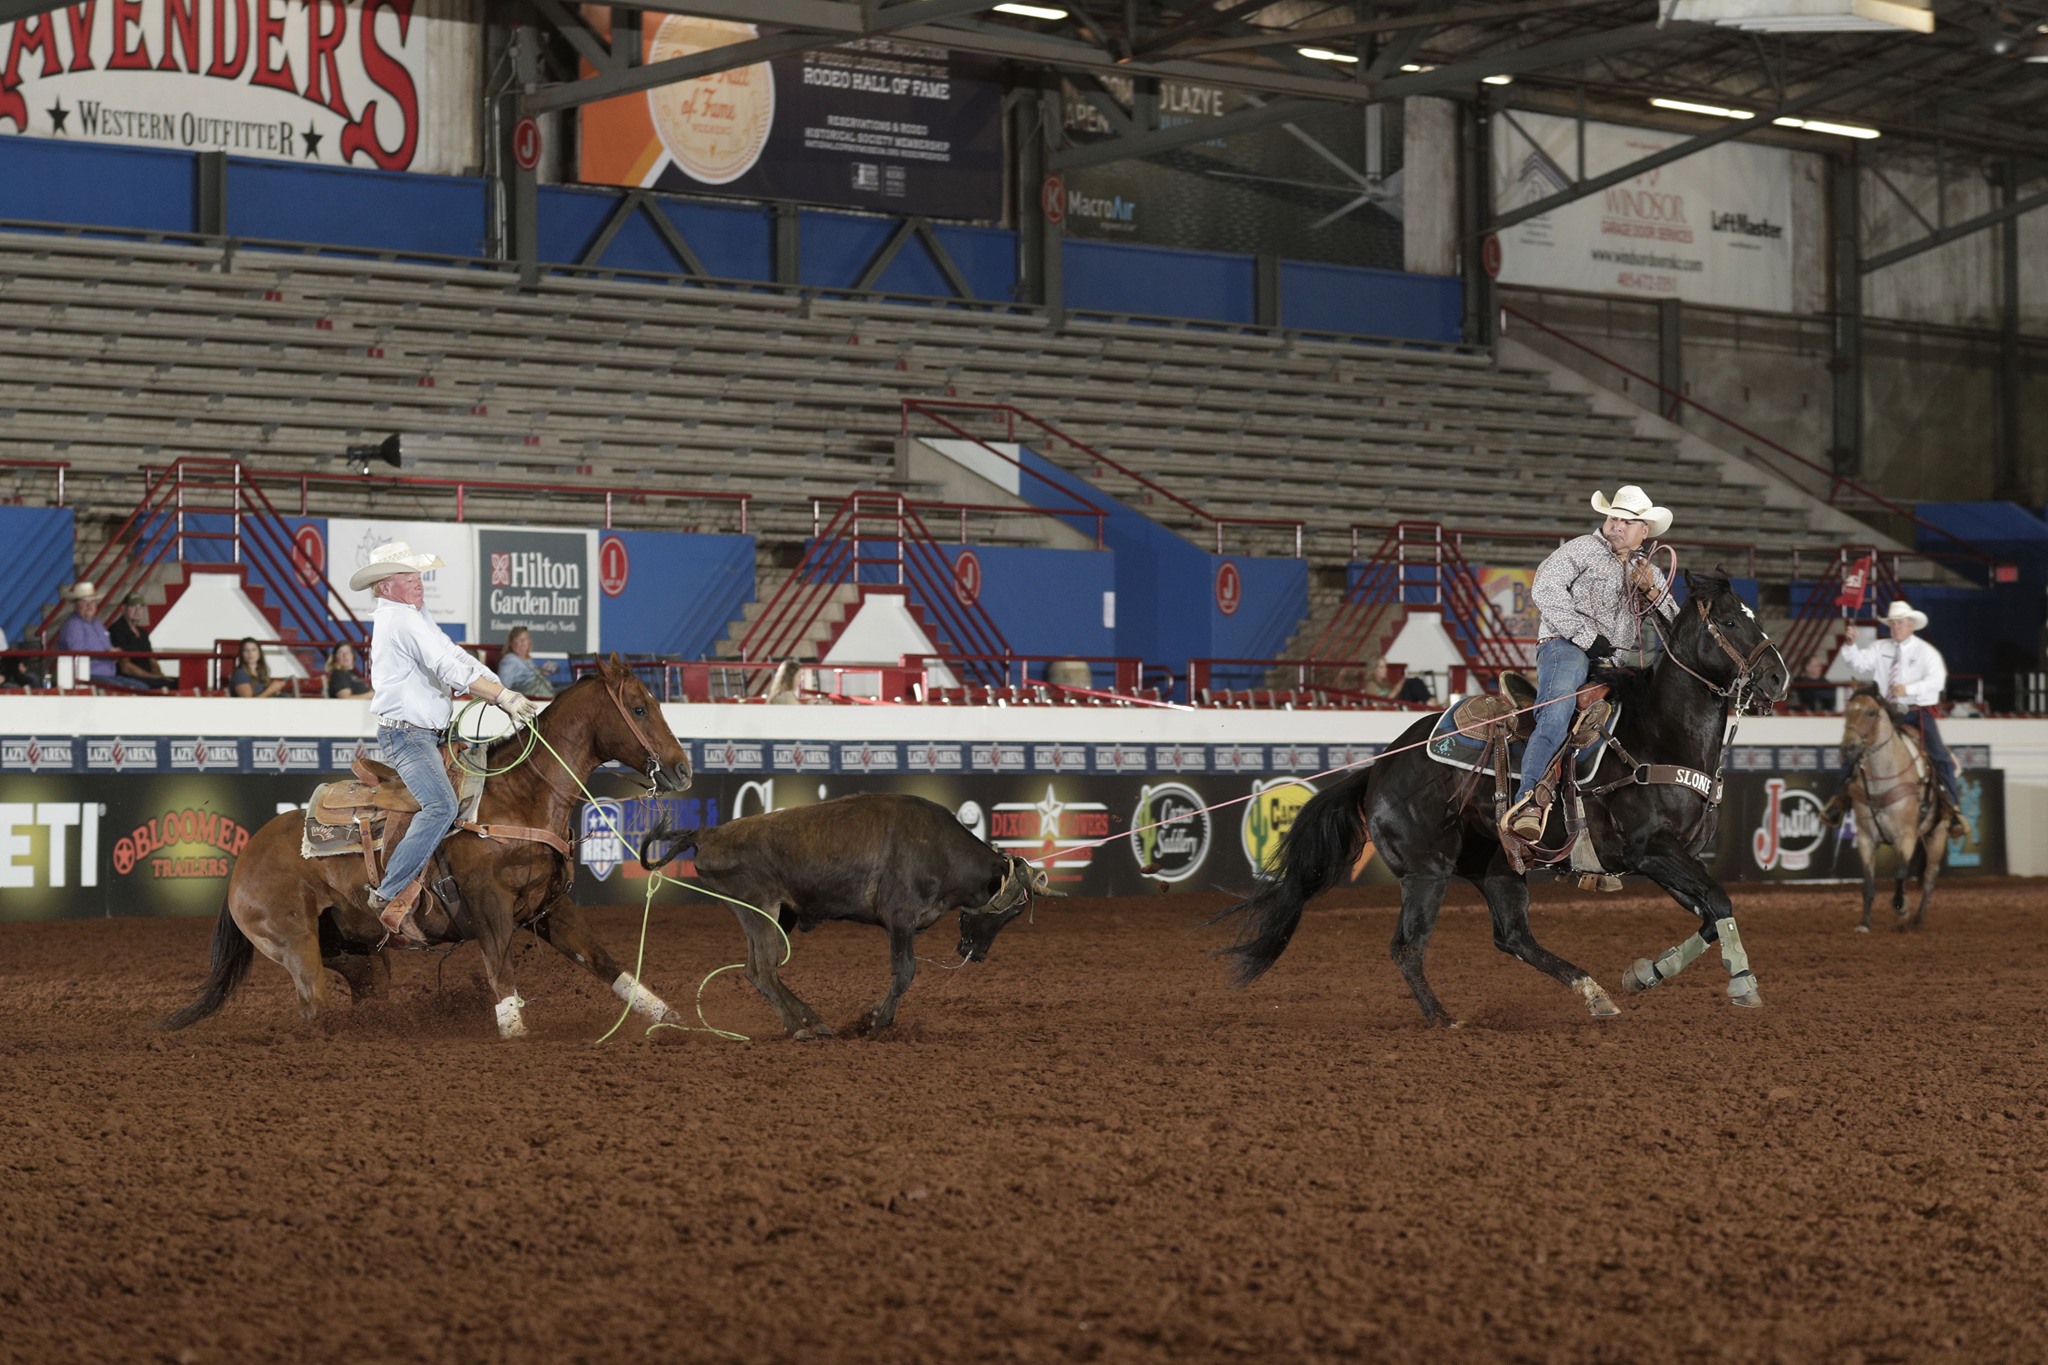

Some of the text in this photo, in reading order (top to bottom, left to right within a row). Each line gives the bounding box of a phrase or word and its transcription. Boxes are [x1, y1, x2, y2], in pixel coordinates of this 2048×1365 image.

[0, 0, 419, 172] AVENDERS
[803, 67, 950, 99] RODEO HALL OF FAME
[78, 100, 295, 156] WESTERN OUTFITTER
[510, 552, 580, 589] Hilton
[490, 589, 579, 617] Garden Inn
[2, 748, 24, 761] LAZY
[43, 748, 72, 761] ARENA
[87, 748, 109, 761] LAZY
[127, 748, 157, 761] ARENA
[171, 748, 194, 762] LAZY
[208, 748, 239, 762] ARENA
[253, 748, 275, 762] LAZY
[290, 748, 319, 762] ARENA
[704, 750, 724, 762] LAZY
[737, 750, 763, 762] ARENA
[773, 750, 791, 763] LAZY
[806, 750, 831, 763] ARENA
[1675, 769, 1712, 795] SLONE
[132, 810, 250, 864] BLOOMER
[991, 812, 1039, 837] DIXON
[1153, 828, 1198, 860] Saddlery
[152, 858, 228, 879] TRAILERS
